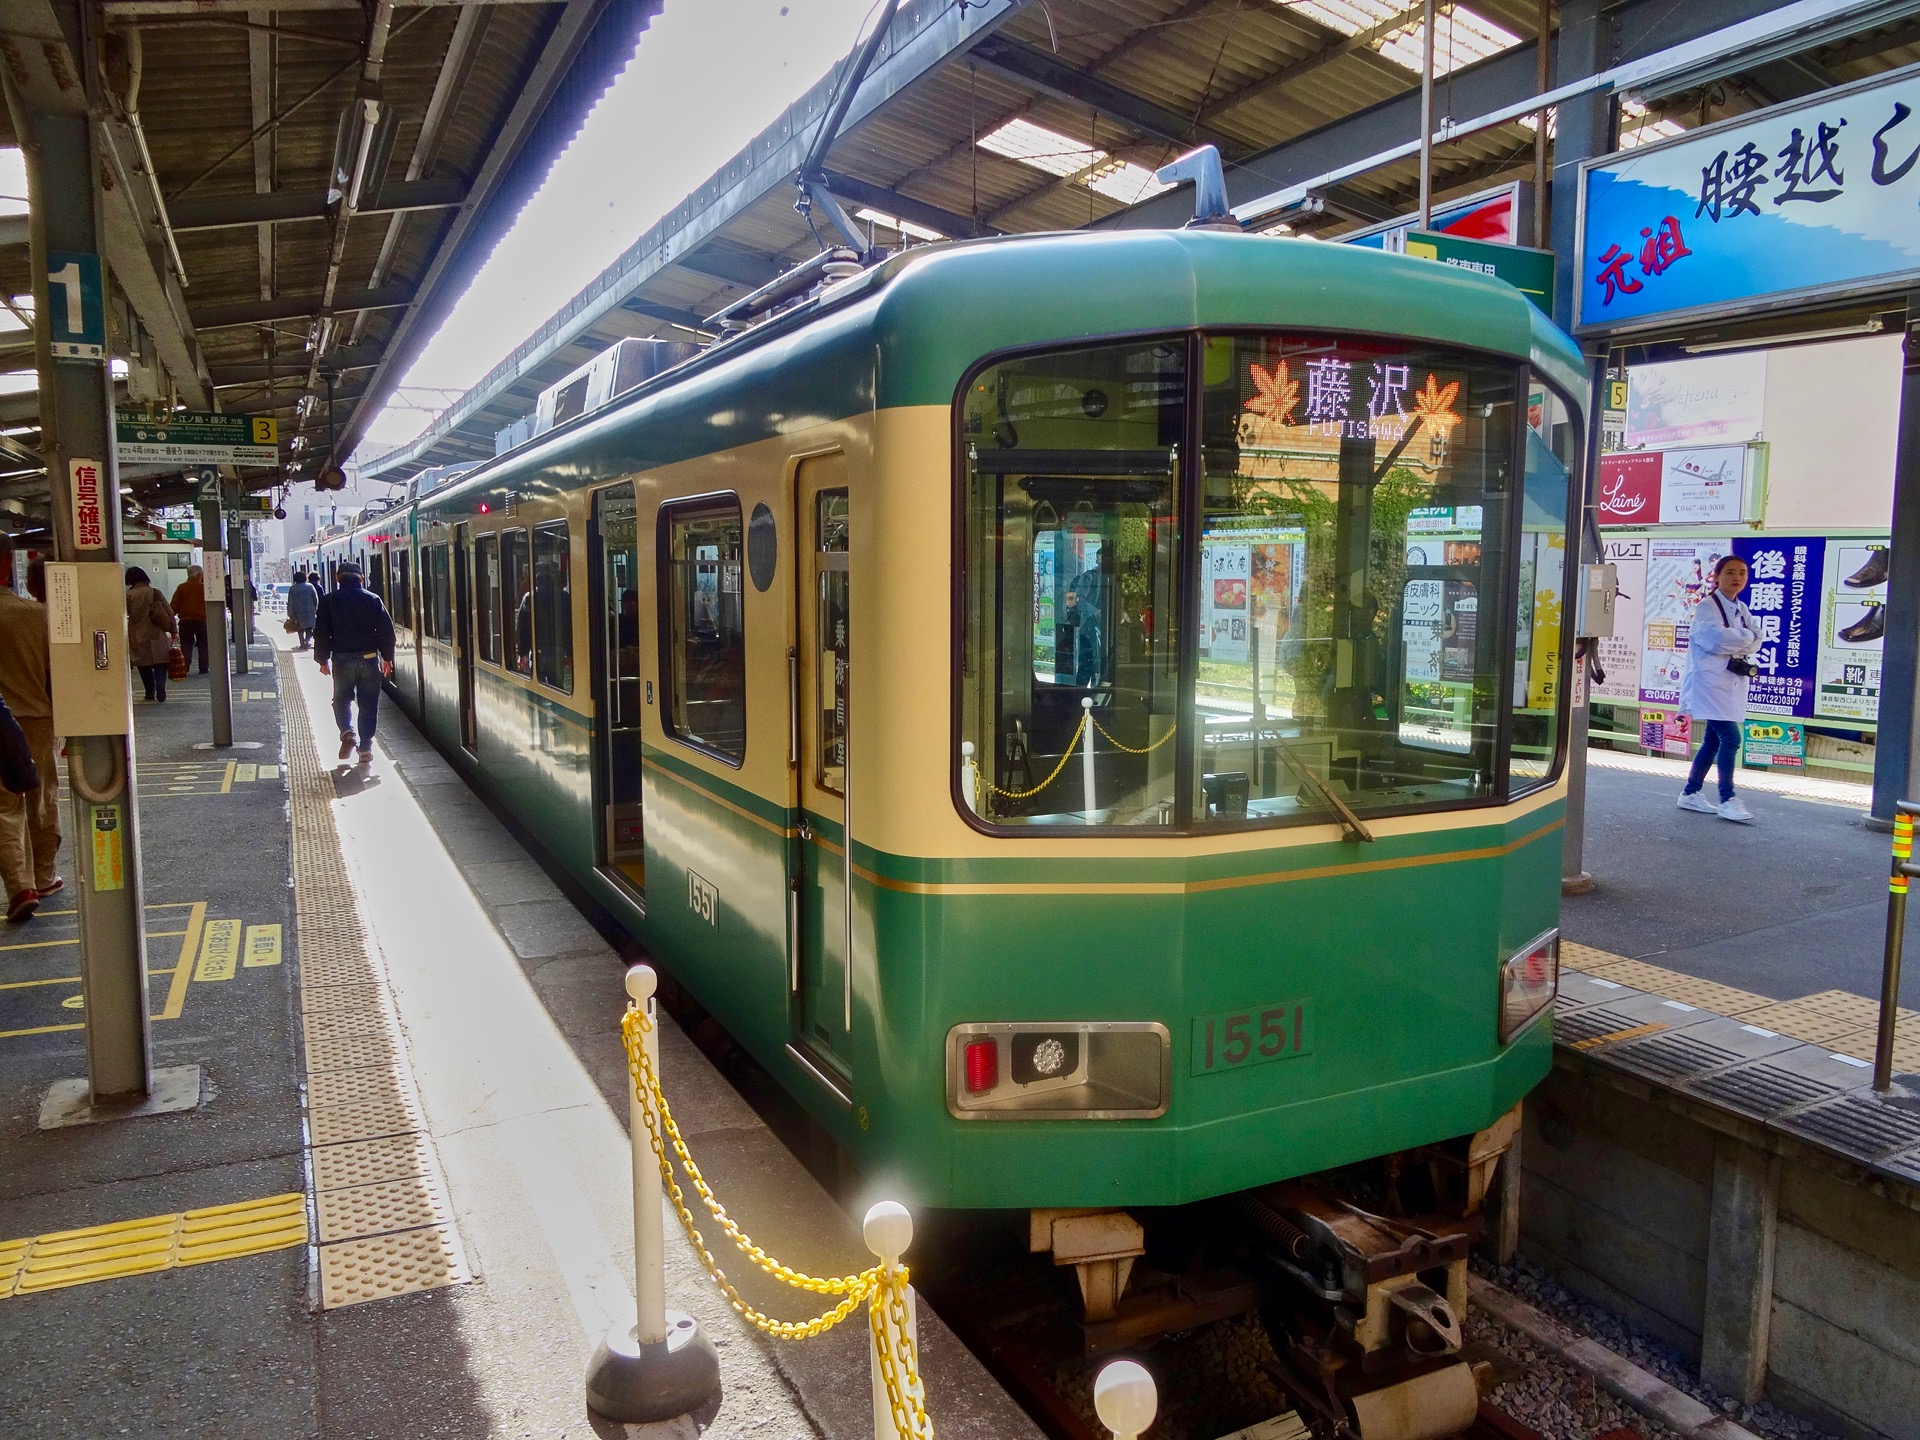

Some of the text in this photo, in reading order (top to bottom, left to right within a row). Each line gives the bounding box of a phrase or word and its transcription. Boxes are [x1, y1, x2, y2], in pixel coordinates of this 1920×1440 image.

[1596, 215, 1693, 308] 元祖
[48, 262, 83, 334] 1
[1305, 358, 1409, 424] 藤沢
[1615, 386, 1622, 406] 5
[259, 421, 270, 440] 3
[1309, 417, 1405, 442] FUJISAWA
[201, 469, 216, 493] 2
[75, 465, 101, 545] 信号確認
[229, 508, 239, 523] 3
[1604, 542, 1642, 558] バレエ
[1748, 550, 1786, 675] 後藤眼科
[1846, 666, 1863, 684] 靴
[1752, 727, 1780, 737] お掃除
[688, 872, 715, 927] 1551
[1204, 1005, 1303, 1070] 1551
